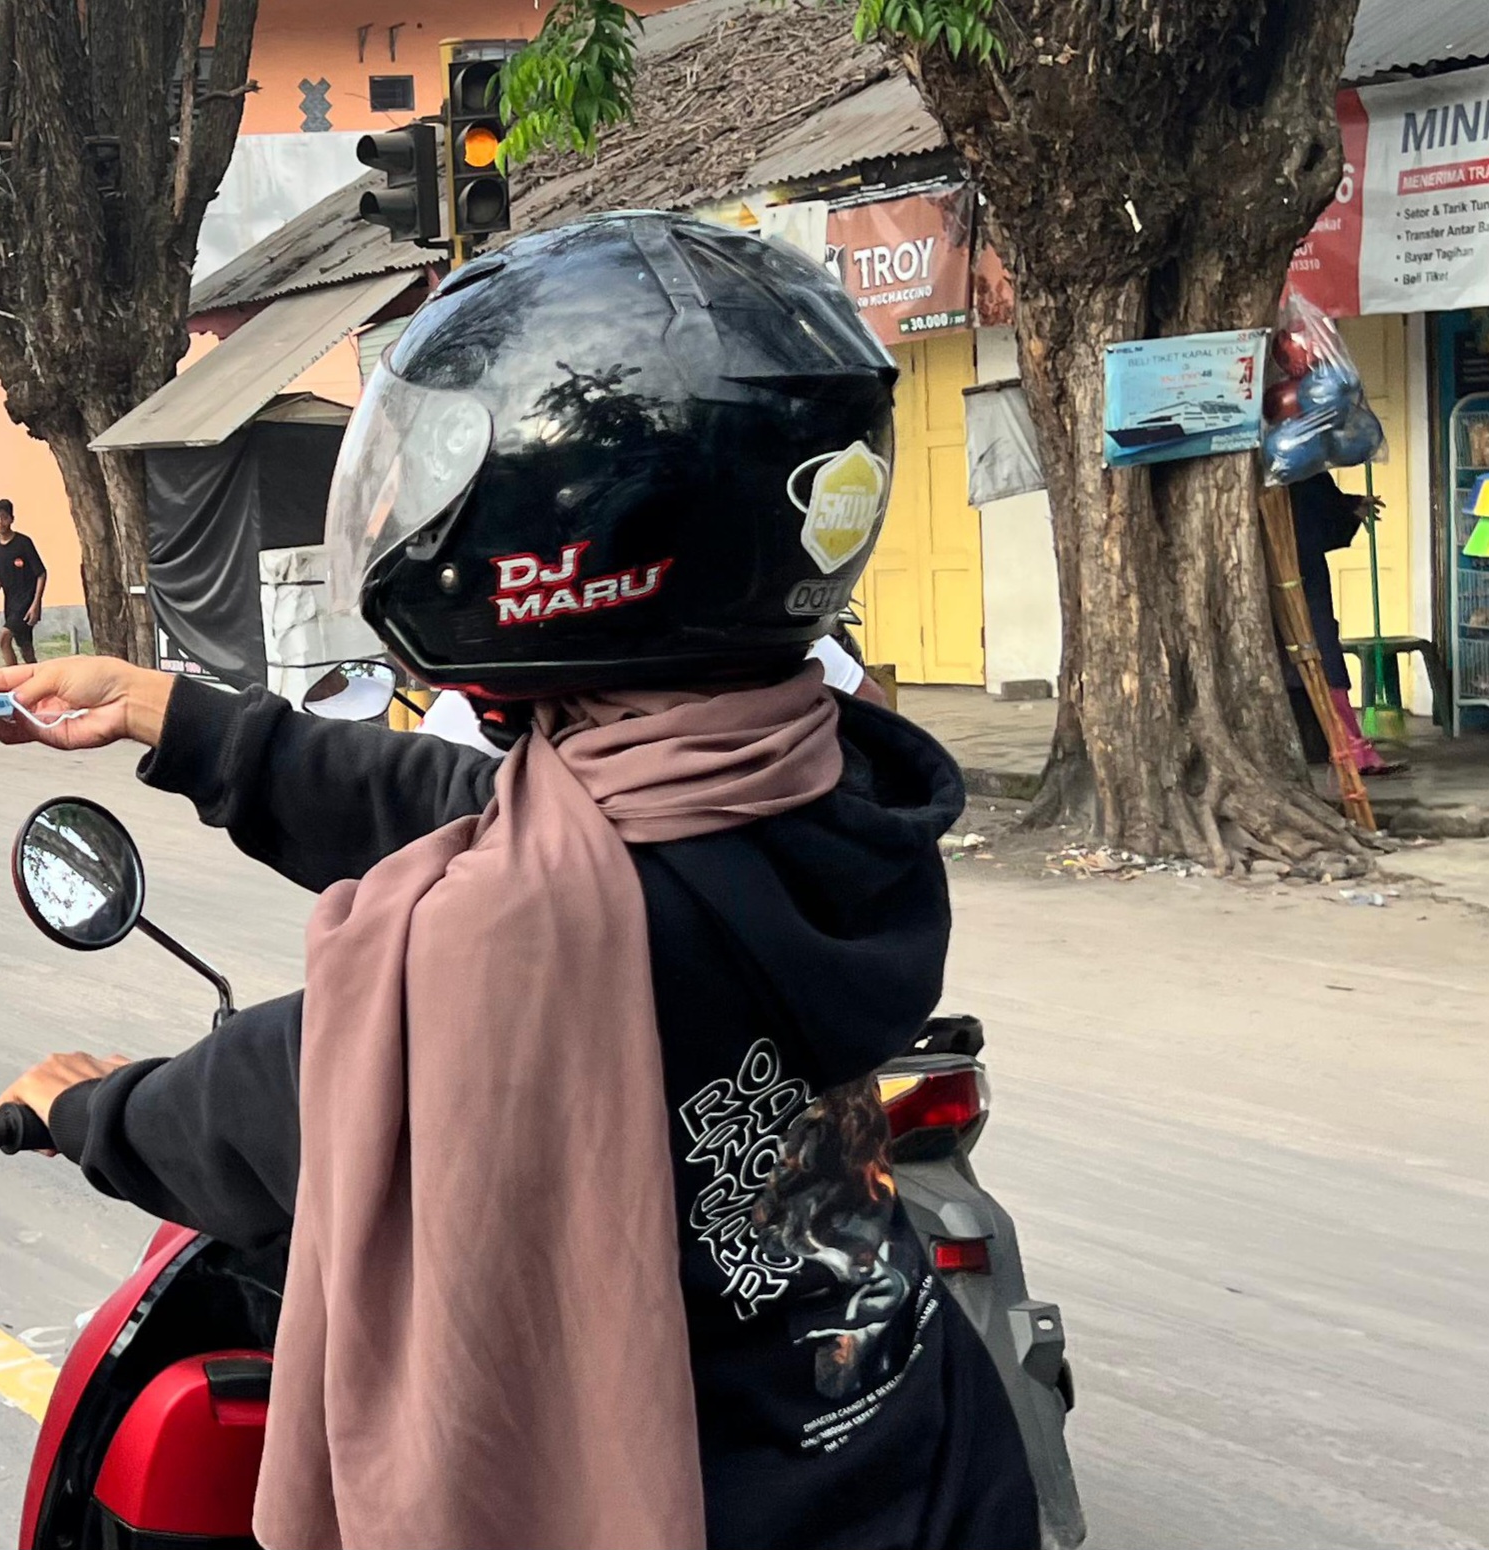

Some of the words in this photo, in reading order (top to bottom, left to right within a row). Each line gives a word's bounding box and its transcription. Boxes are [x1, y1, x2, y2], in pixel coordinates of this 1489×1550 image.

[1403, 169, 1465, 189] MENERIMA
[1404, 208, 1430, 220] Setor
[1432, 204, 1440, 216] &
[1443, 202, 1468, 214] Tarik
[1405, 227, 1445, 241] Transfer
[1447, 225, 1475, 237] Antar
[853, 237, 935, 289] TROY
[1404, 251, 1433, 265] Bayar
[1435, 247, 1474, 261] Tagihan
[870, 285, 933, 306] MOCHACCINO
[910, 312, 948, 332] 30.000
[1152, 353, 1179, 363] TIKET
[1182, 350, 1213, 360] KAPAL
[498, 546, 581, 590] DJ
[496, 564, 663, 623] MARU
